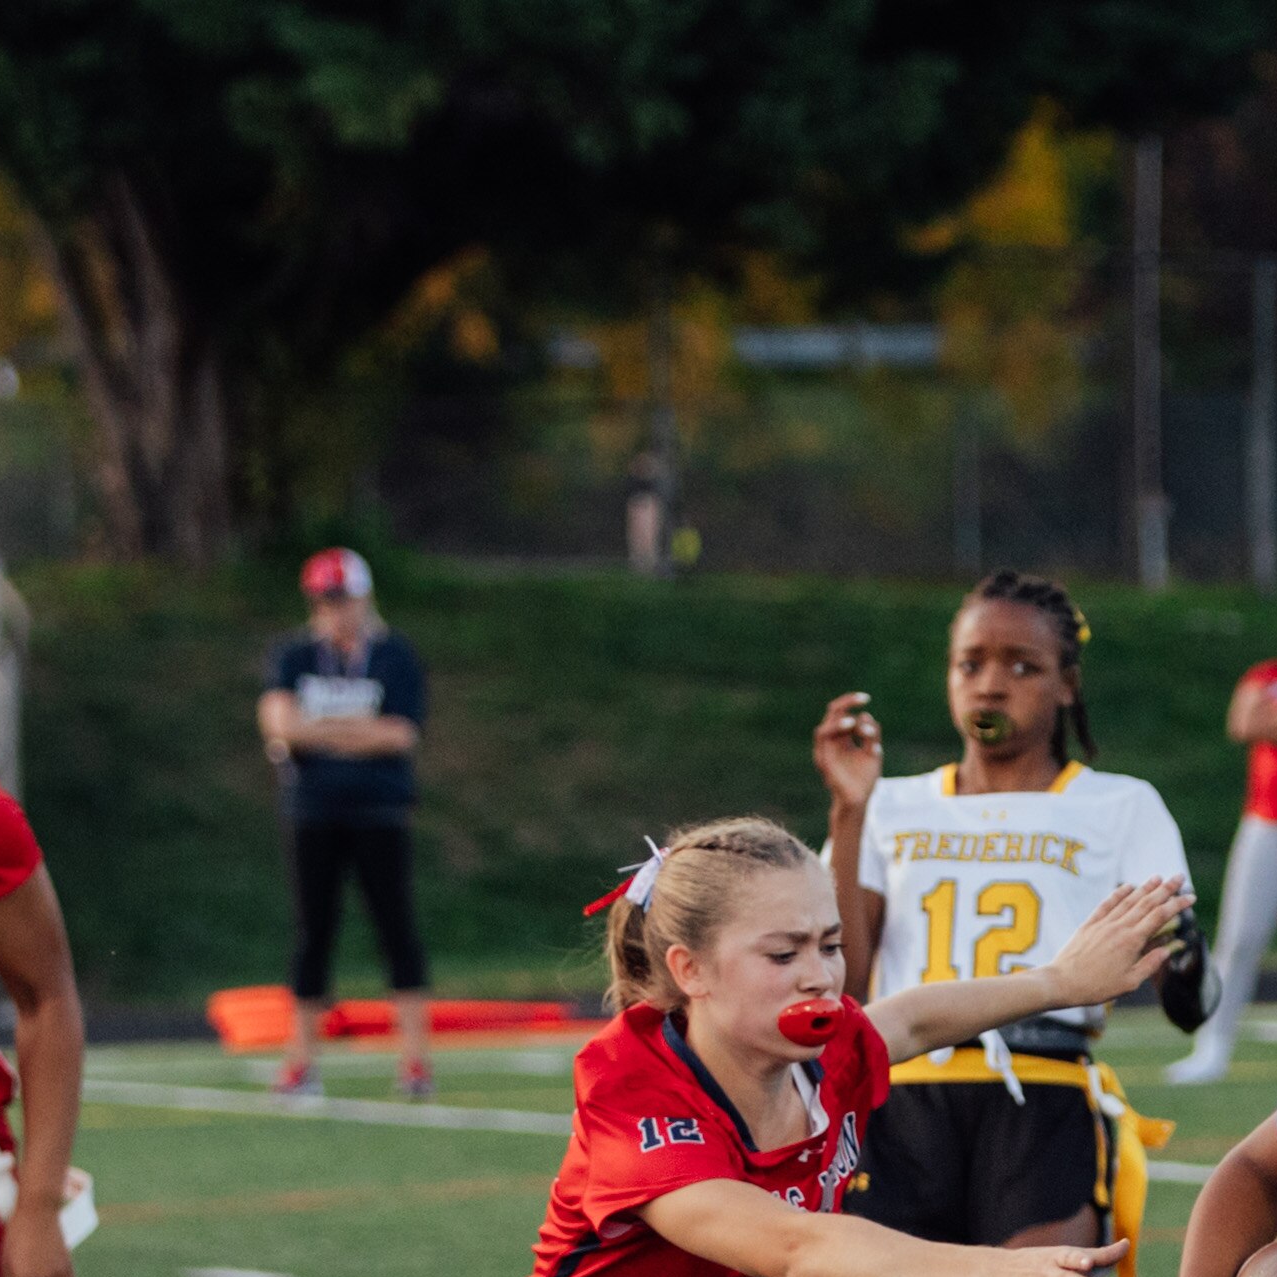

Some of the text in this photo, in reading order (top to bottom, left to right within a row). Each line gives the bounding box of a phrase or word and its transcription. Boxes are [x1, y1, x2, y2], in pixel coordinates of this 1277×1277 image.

[892, 829, 1087, 877] FREDERICK
[920, 877, 1043, 987] 12
[637, 1116, 706, 1153] 12
